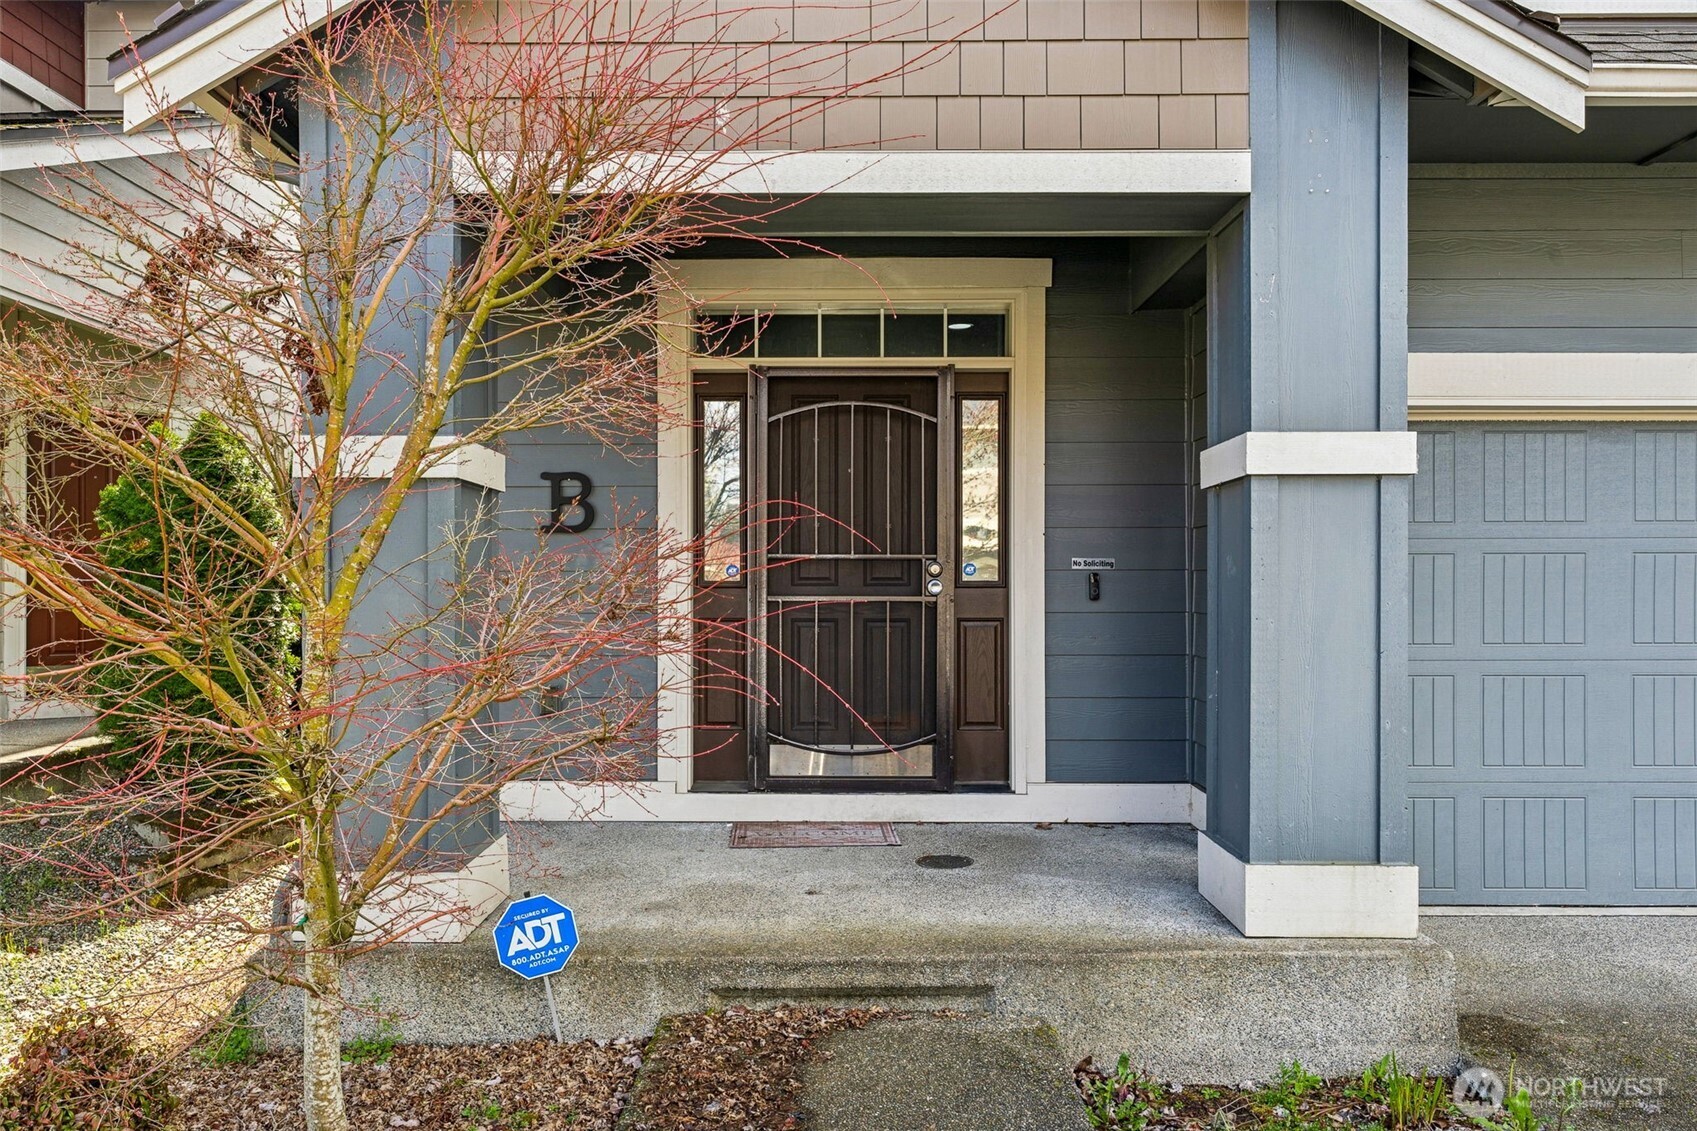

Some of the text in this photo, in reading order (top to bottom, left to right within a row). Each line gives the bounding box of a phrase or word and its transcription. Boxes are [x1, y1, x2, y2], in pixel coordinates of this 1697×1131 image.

[540, 471, 594, 533] B
[1083, 560, 1114, 568] Soliciting
[753, 829, 874, 838] WELCOME
[513, 910, 540, 921] SECURED
[507, 912, 565, 957] ADT
[511, 944, 570, 966] 800.ADT.ASAP
[529, 957, 556, 968] ADT.COM
